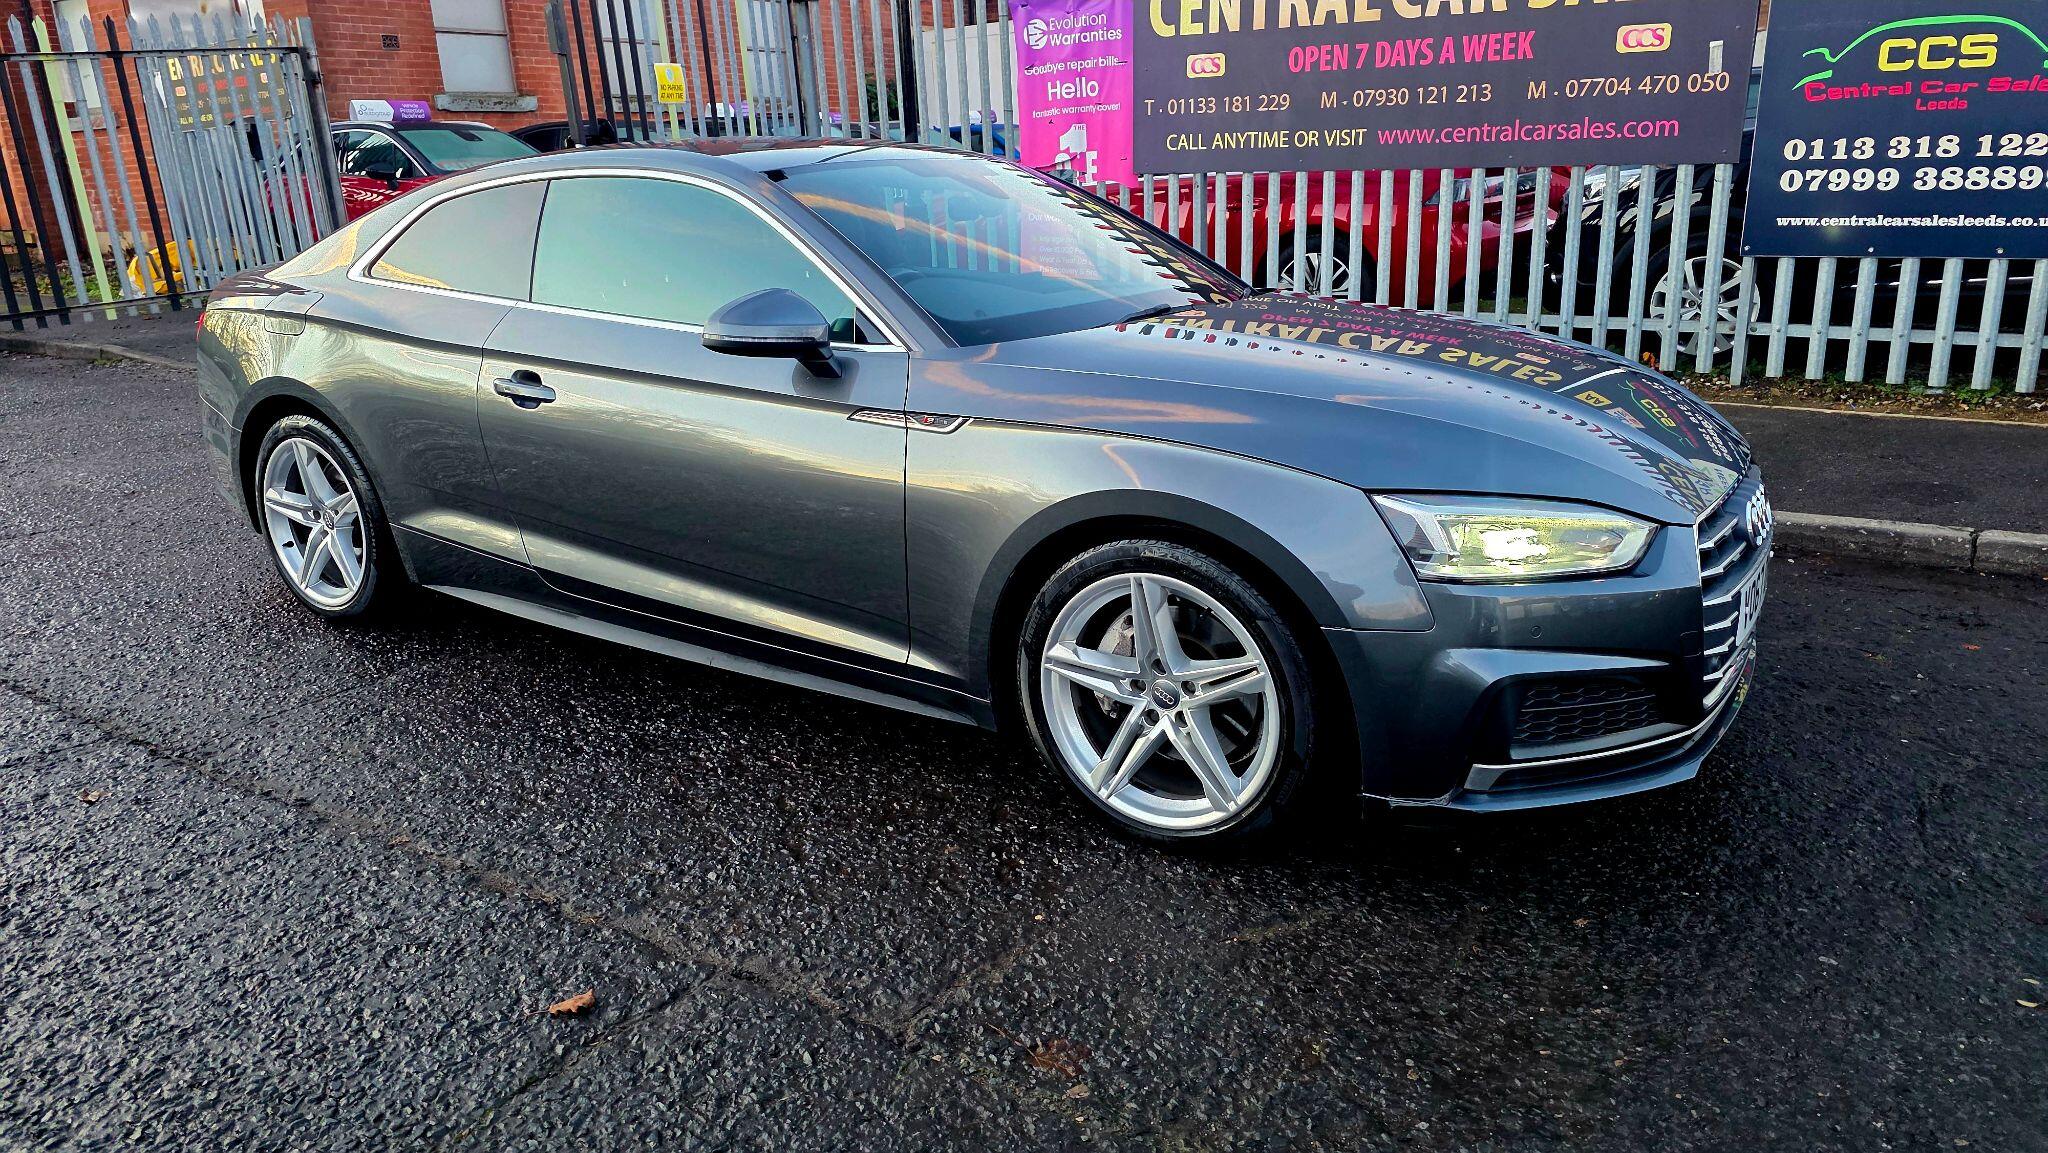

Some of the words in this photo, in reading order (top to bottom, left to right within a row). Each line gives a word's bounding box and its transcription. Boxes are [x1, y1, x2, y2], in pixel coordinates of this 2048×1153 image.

[1049, 12, 1107, 31] Evolution
[1049, 28, 1122, 47] Warranties
[1622, 28, 1666, 49] CCS
[1288, 44, 1349, 73] OPEN
[1354, 42, 1370, 70] 7
[1375, 37, 1434, 68] DAYS
[1438, 35, 1456, 65] A
[1462, 30, 1536, 63] WEEK
[1878, 33, 1998, 72] CCS
[1067, 57, 1098, 72] repair
[1190, 56, 1221, 75] CCS
[1047, 76, 1099, 102] Hello
[1167, 97, 1217, 115] 01133
[1223, 96, 1251, 113] 181
[1258, 94, 1291, 112] 229
[1352, 87, 1410, 108] 07930
[1416, 86, 1448, 104] 121
[1456, 83, 1492, 104] 213
[1565, 77, 1632, 98] 07704
[1638, 74, 1680, 94] 470
[1687, 71, 1730, 93] 050
[1804, 81, 1912, 102] Central
[1920, 80, 1979, 95] Car
[1062, 104, 1096, 116] warranty
[1915, 97, 1968, 111] Leeds
[1166, 133, 1207, 151] CALL
[1212, 130, 1290, 150] ANYTIME
[1294, 129, 1319, 148] OR
[1324, 128, 1367, 146] VISIT
[1377, 116, 1680, 146] www.centralcarsales.com
[1783, 136, 1875, 161] 0113
[1886, 134, 1961, 160] 318
[1779, 166, 1901, 193] 07999
[1912, 165, 2048, 191] 38889
